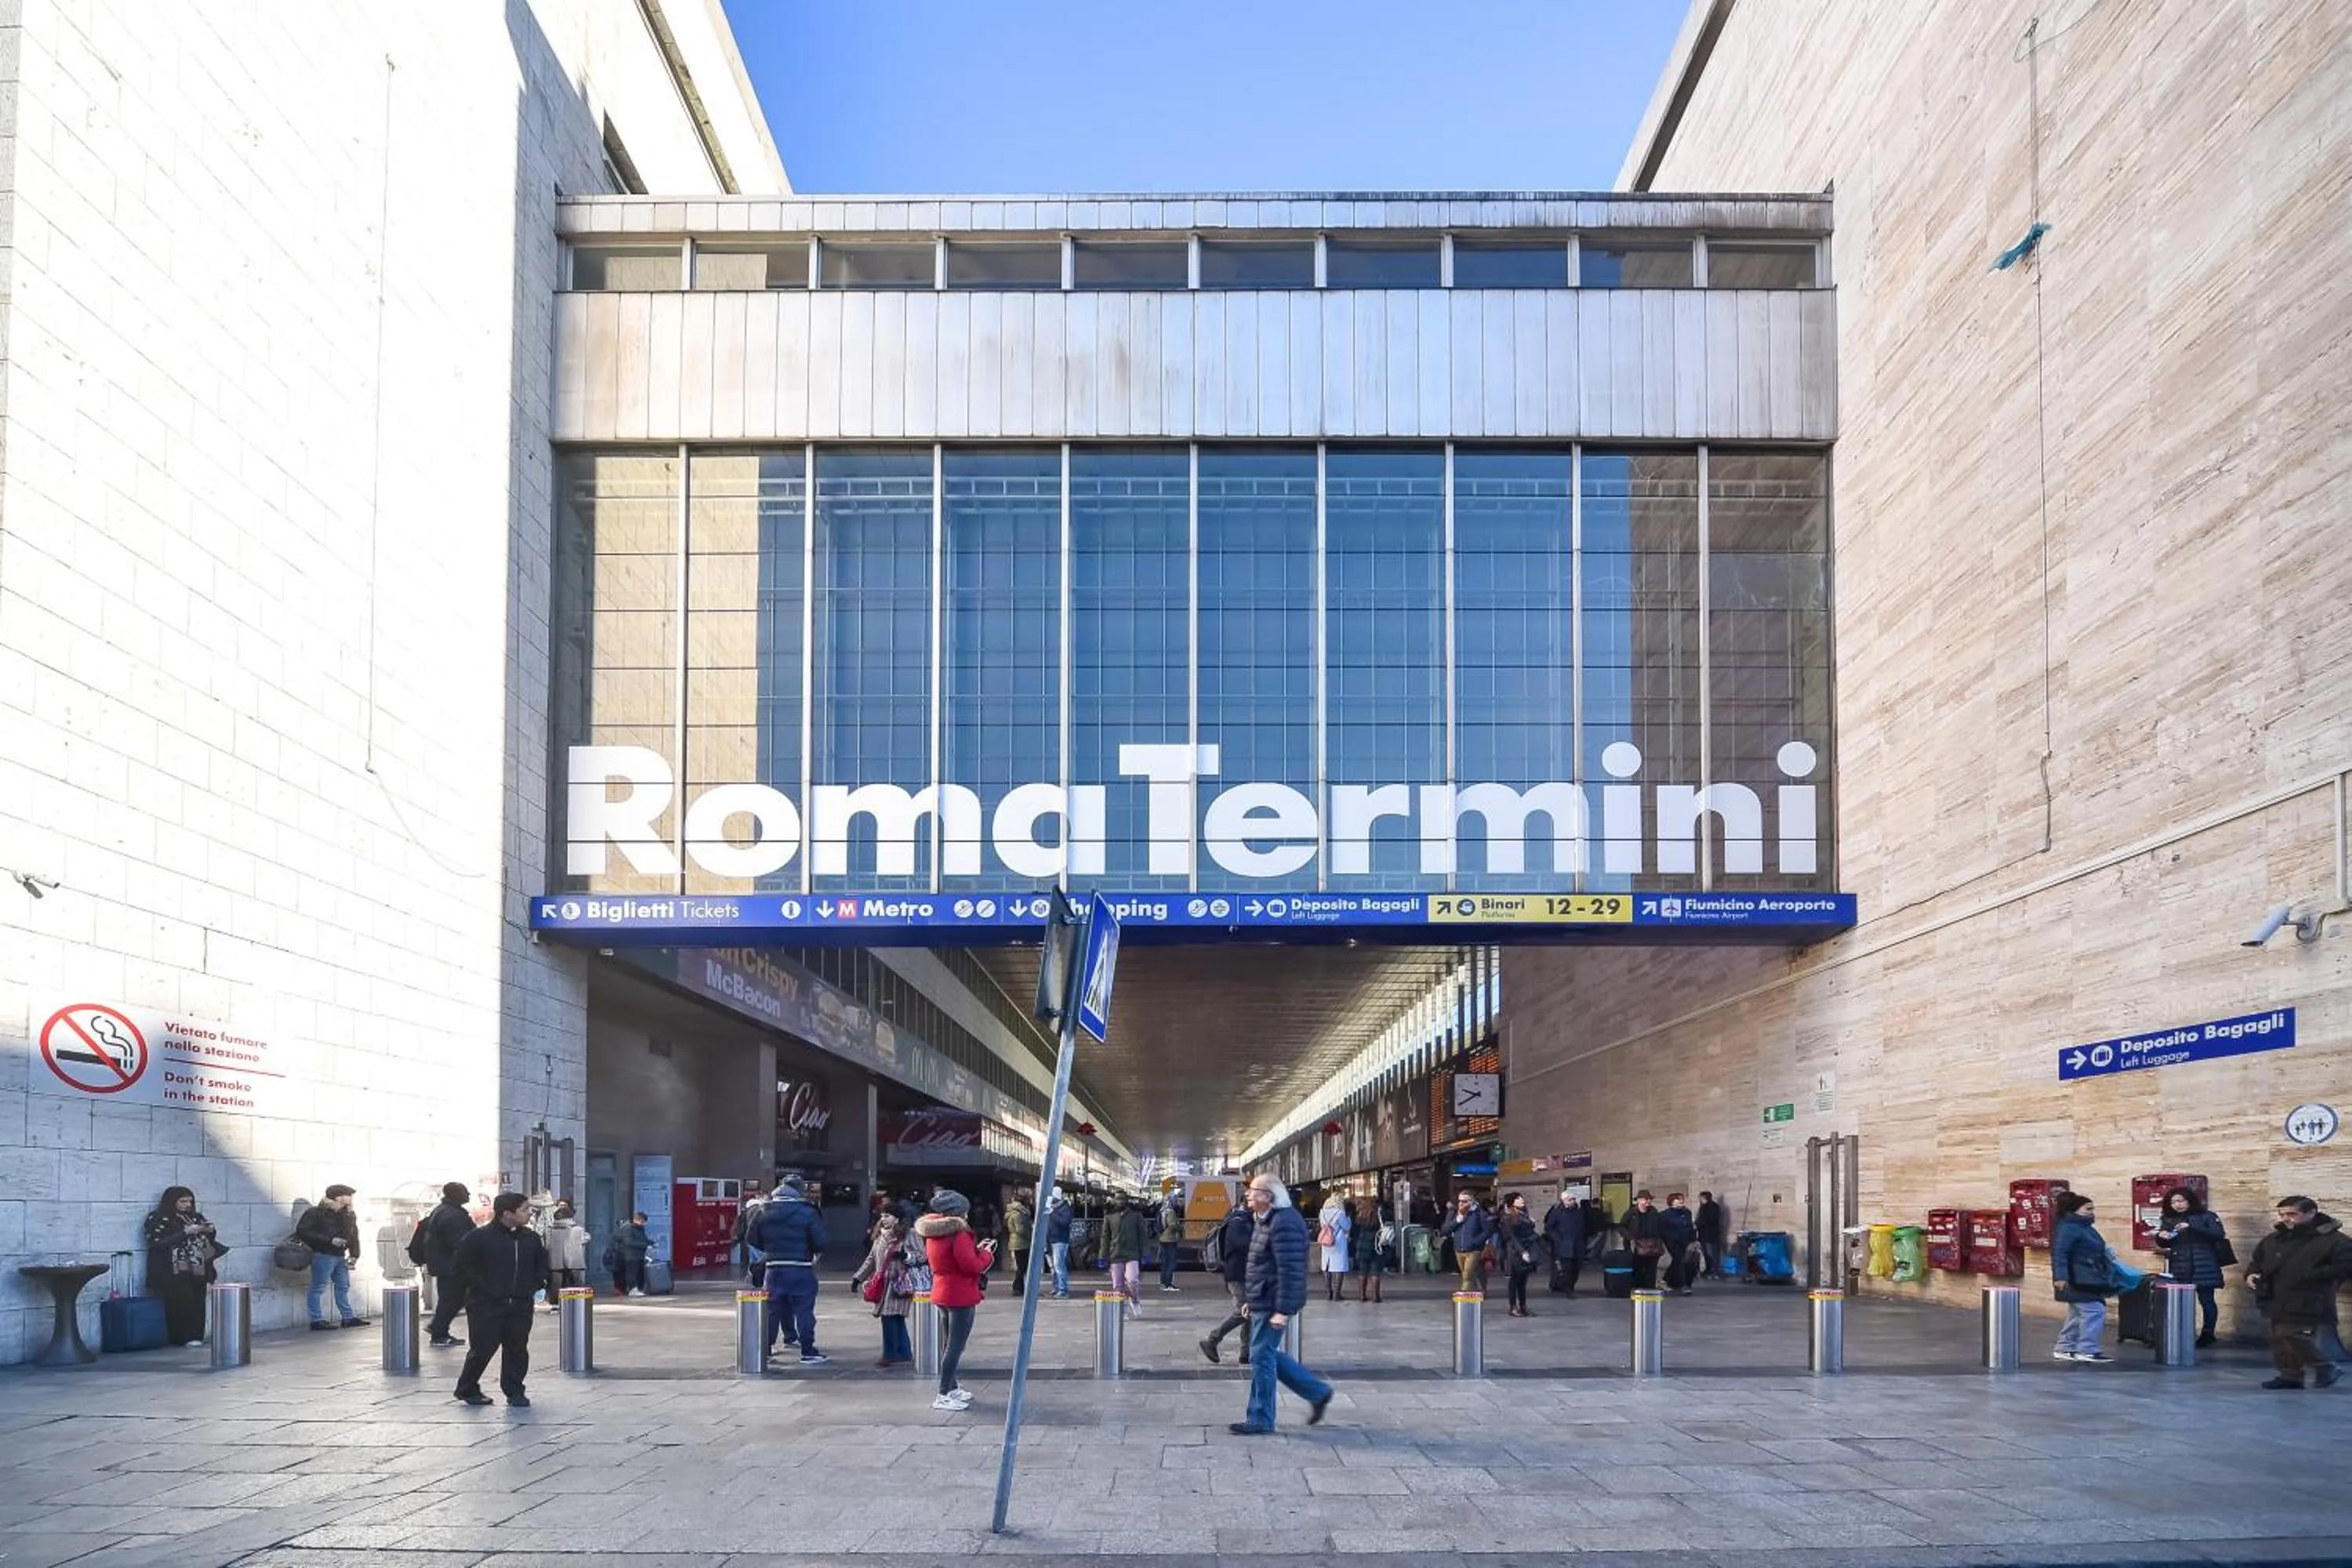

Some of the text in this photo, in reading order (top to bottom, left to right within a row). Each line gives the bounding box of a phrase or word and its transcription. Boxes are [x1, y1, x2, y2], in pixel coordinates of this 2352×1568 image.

[587, 900, 739, 922] Biglietti Tickets
[863, 899, 934, 916] Metro
[1290, 898, 1420, 913] Deposito Bagagli
[1481, 898, 1525, 910] Binari
[1686, 898, 1835, 912] Fiumicino Aeroporto
[1291, 911, 1340, 921] Left Luggage
[1722, 912, 1748, 920] Airport
[706, 959, 782, 1018] McBacon
[165, 1022, 268, 1050] Vietato fumare
[2121, 1012, 2285, 1054] Deposito Bagagli
[165, 1040, 260, 1062] nella stazione
[2121, 1051, 2190, 1069] Left Luggage
[164, 1071, 252, 1092] Don't smoke
[164, 1087, 255, 1108] in the station
[789, 1081, 832, 1130] Ciao
[897, 1113, 980, 1152] Ciao
